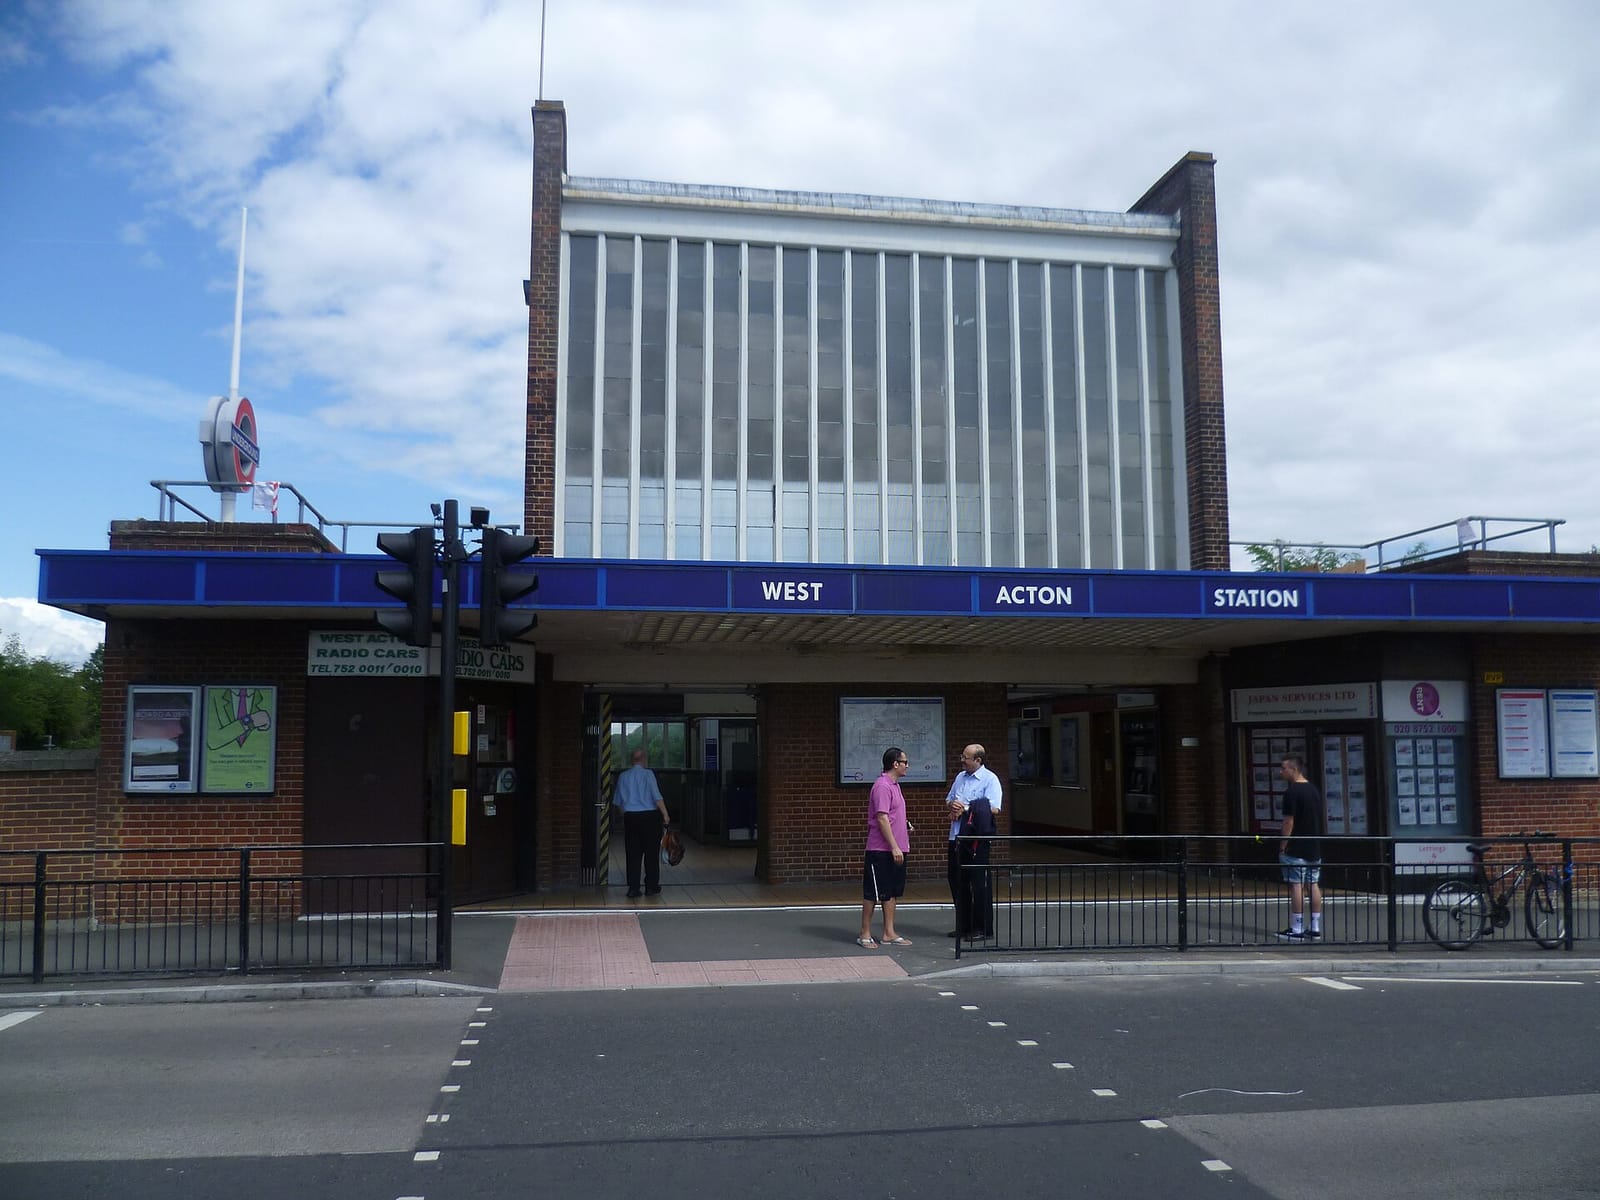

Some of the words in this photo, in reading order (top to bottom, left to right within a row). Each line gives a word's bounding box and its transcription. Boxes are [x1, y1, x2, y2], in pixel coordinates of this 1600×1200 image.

[761, 581, 823, 601] WEST
[995, 585, 1072, 605] ACTON
[1213, 588, 1298, 608] STATION
[319, 633, 364, 643] WEST
[316, 648, 370, 658] RADIO
[374, 648, 420, 658] CARS
[490, 652, 524, 671] CARS
[311, 664, 332, 673] TEL
[334, 664, 355, 673] 752
[1247, 694, 1279, 705] JAPAN
[1281, 692, 1331, 703] SERVICES
[1334, 690, 1356, 700] LTD
[1416, 687, 1424, 713] RENT
[1394, 724, 1409, 734] 020
